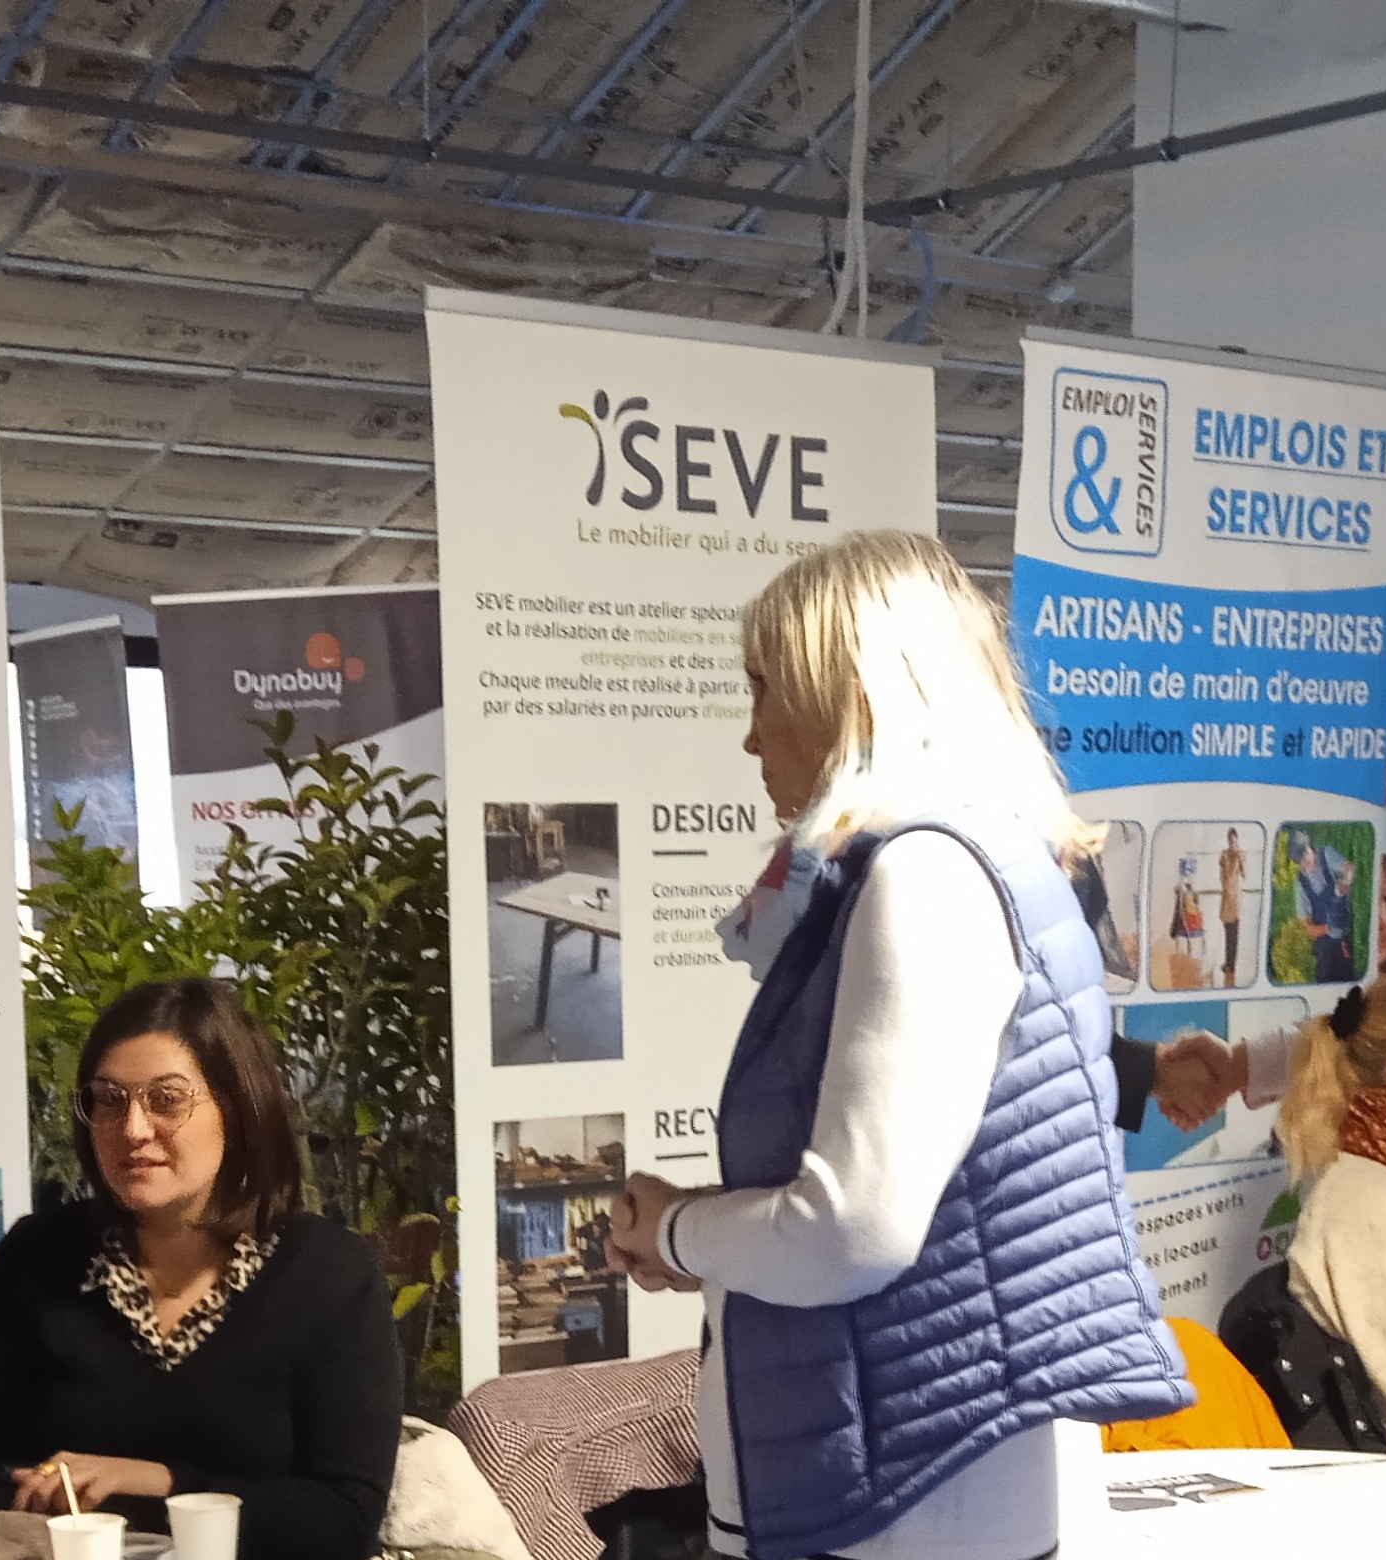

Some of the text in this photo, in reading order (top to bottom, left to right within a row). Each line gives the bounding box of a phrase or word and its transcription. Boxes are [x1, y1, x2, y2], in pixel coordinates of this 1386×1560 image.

[1194, 407, 1348, 469] EMPLOIS
[621, 420, 830, 523] SEVE
[1062, 385, 1158, 539] EMPLOI SERVICES
[1063, 424, 1122, 535] &
[1206, 485, 1372, 545] SERVICES
[578, 518, 778, 556] Le mobilier qui a du
[476, 592, 514, 612] SEVE
[519, 594, 584, 616] mobilier
[588, 601, 612, 617] est
[616, 603, 636, 618] un
[638, 601, 686, 618] atelier
[486, 621, 502, 638] et
[506, 619, 520, 637] la
[524, 619, 608, 640] réalisation
[611, 624, 632, 641] de
[1034, 594, 1184, 645] ARTISANS
[1213, 605, 1385, 656] ENTREPRISES
[669, 655, 686, 670] et
[688, 653, 715, 670] des
[233, 668, 342, 697] Dynabuy
[479, 669, 541, 692] Chaque
[545, 672, 603, 692] meuble
[607, 677, 630, 693] est
[633, 675, 683, 694] réalisé
[699, 677, 738, 698] partir
[1047, 658, 1370, 706] besoin de main d'oeuvre
[483, 699, 510, 718] par
[514, 698, 543, 715] des
[547, 699, 607, 717] salariés
[609, 703, 628, 718] en
[631, 702, 699, 721] parcours
[1081, 721, 1386, 761] solution SIMPLE et RAPIDE
[192, 801, 236, 821] NOS
[652, 803, 756, 834] DESIGN
[652, 882, 733, 899] Convaincus
[653, 905, 707, 922] demain
[653, 931, 666, 944] et
[1135, 1191, 1245, 1236] espaces verts
[1163, 1236, 1220, 1264] locaux
